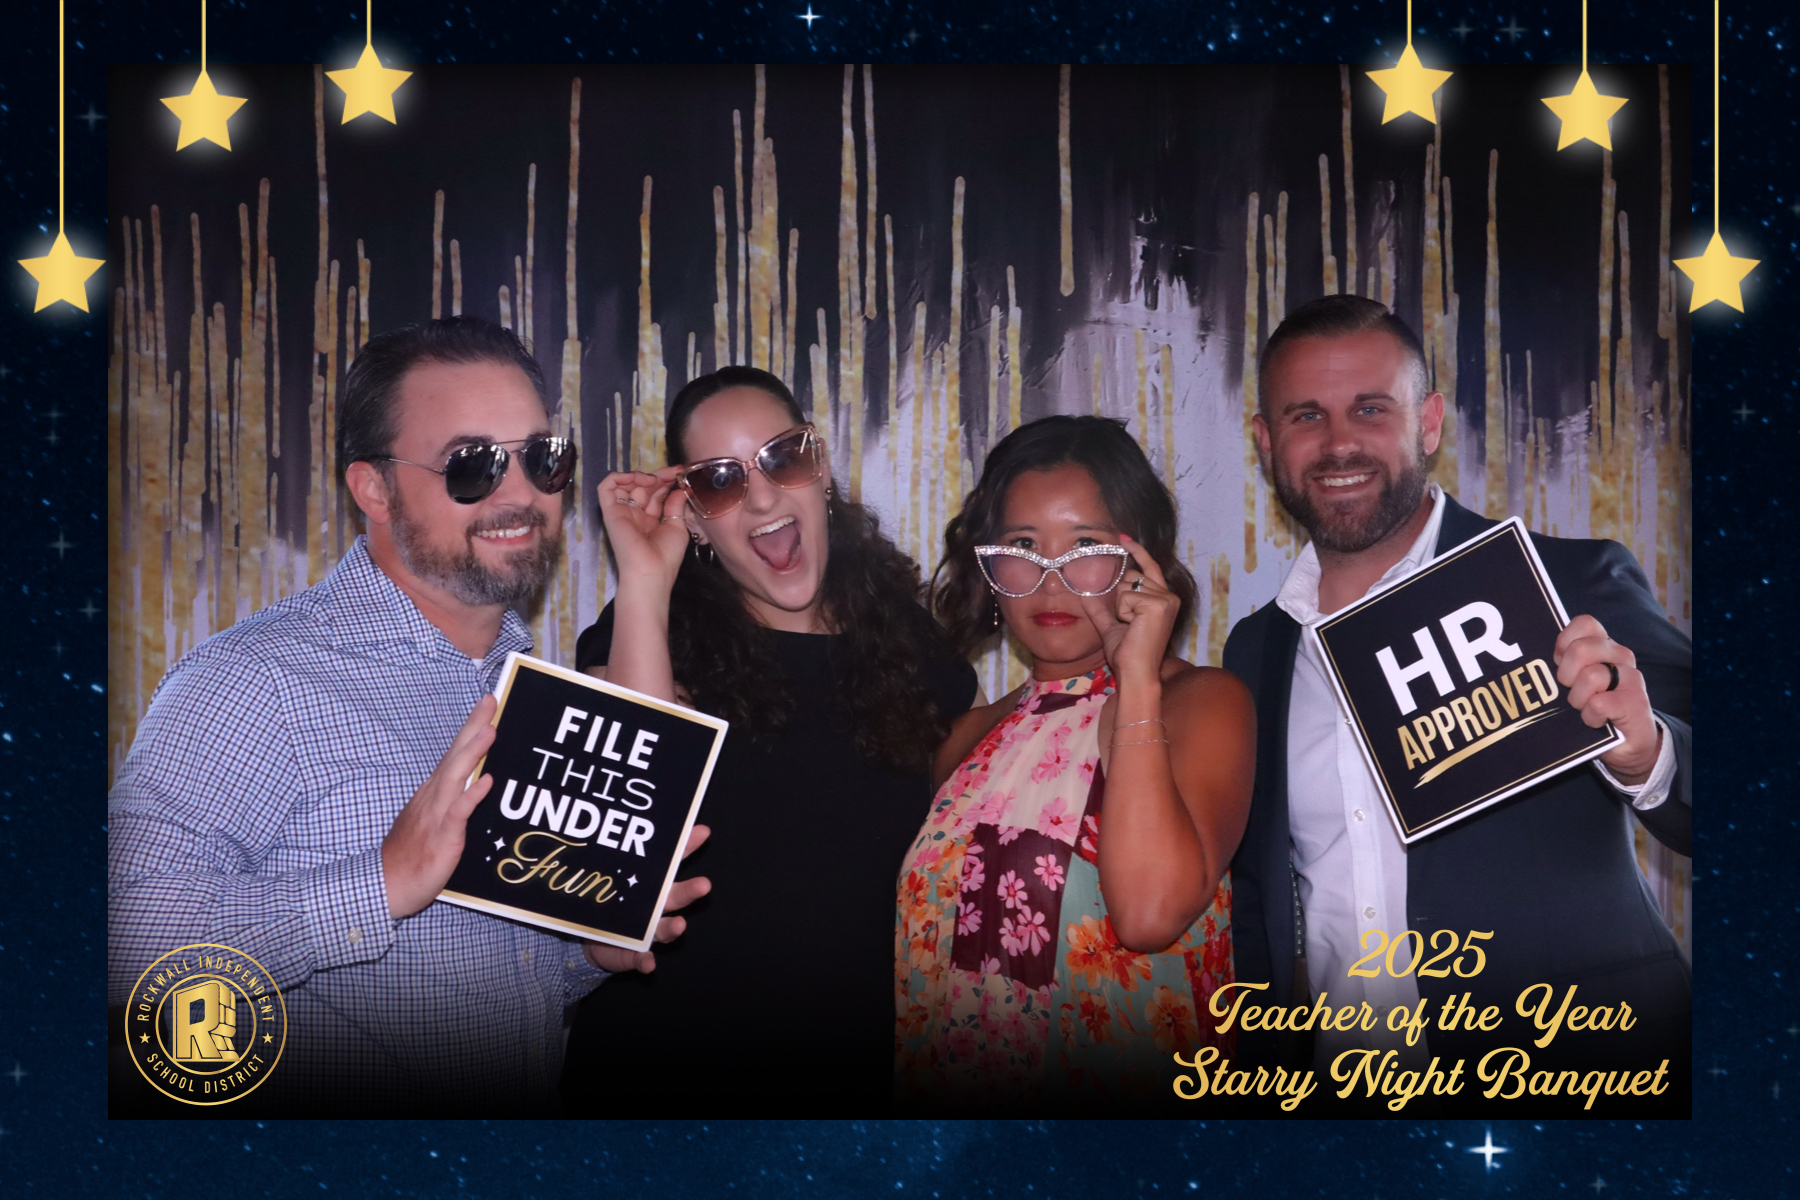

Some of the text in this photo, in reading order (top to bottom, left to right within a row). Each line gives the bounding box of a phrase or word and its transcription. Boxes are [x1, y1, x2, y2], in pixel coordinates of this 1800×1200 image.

[1375, 601, 1524, 716] HR
[554, 706, 659, 770] FILE
[1397, 658, 1559, 770] APPROVED
[533, 747, 656, 811] THIS
[500, 779, 655, 857] UNDER
[497, 831, 617, 903] Fun
